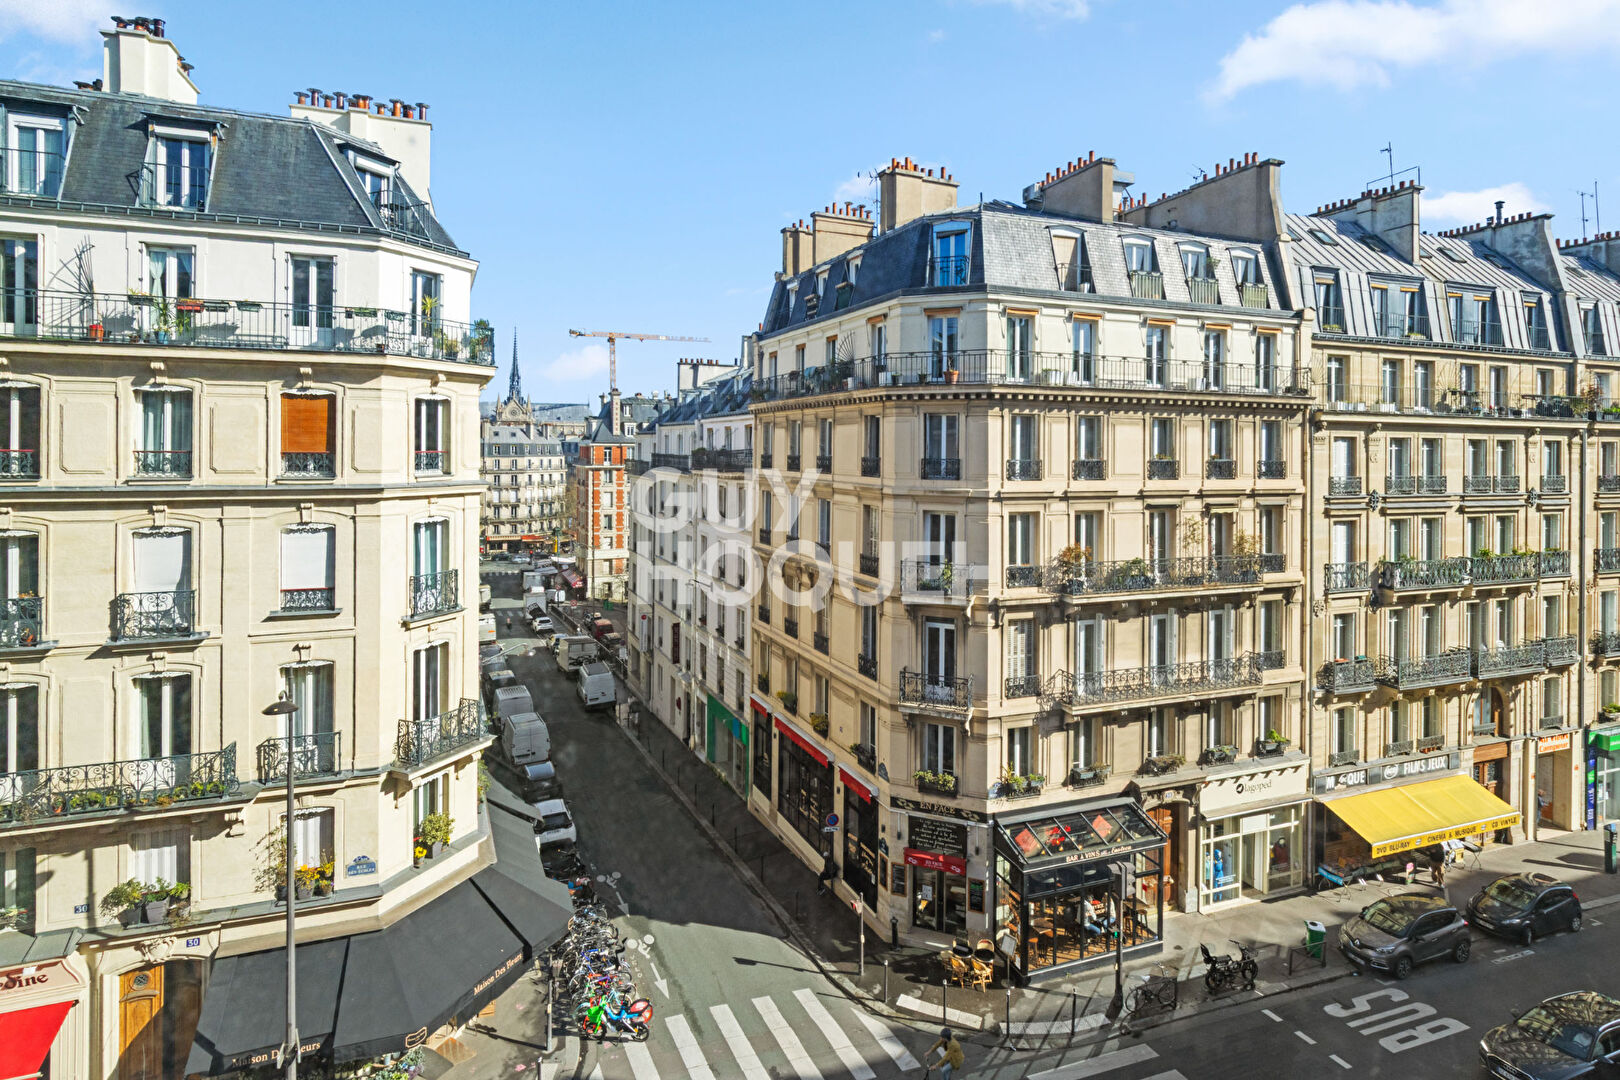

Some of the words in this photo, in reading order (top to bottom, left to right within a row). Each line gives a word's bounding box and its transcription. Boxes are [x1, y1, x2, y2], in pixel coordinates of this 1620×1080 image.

[1326, 770, 1366, 790] MQUE
[1403, 760, 1425, 775] FILMS
[1426, 756, 1446, 771] JEUX
[1454, 827, 1477, 838] MUSIQUE
[75, 904, 88, 914] 30
[187, 937, 200, 947] 30
[0, 973, 49, 991] dine
[474, 975, 495, 996] Maison
[1322, 987, 1471, 1054] BUS
[232, 1053, 268, 1068] Maison
